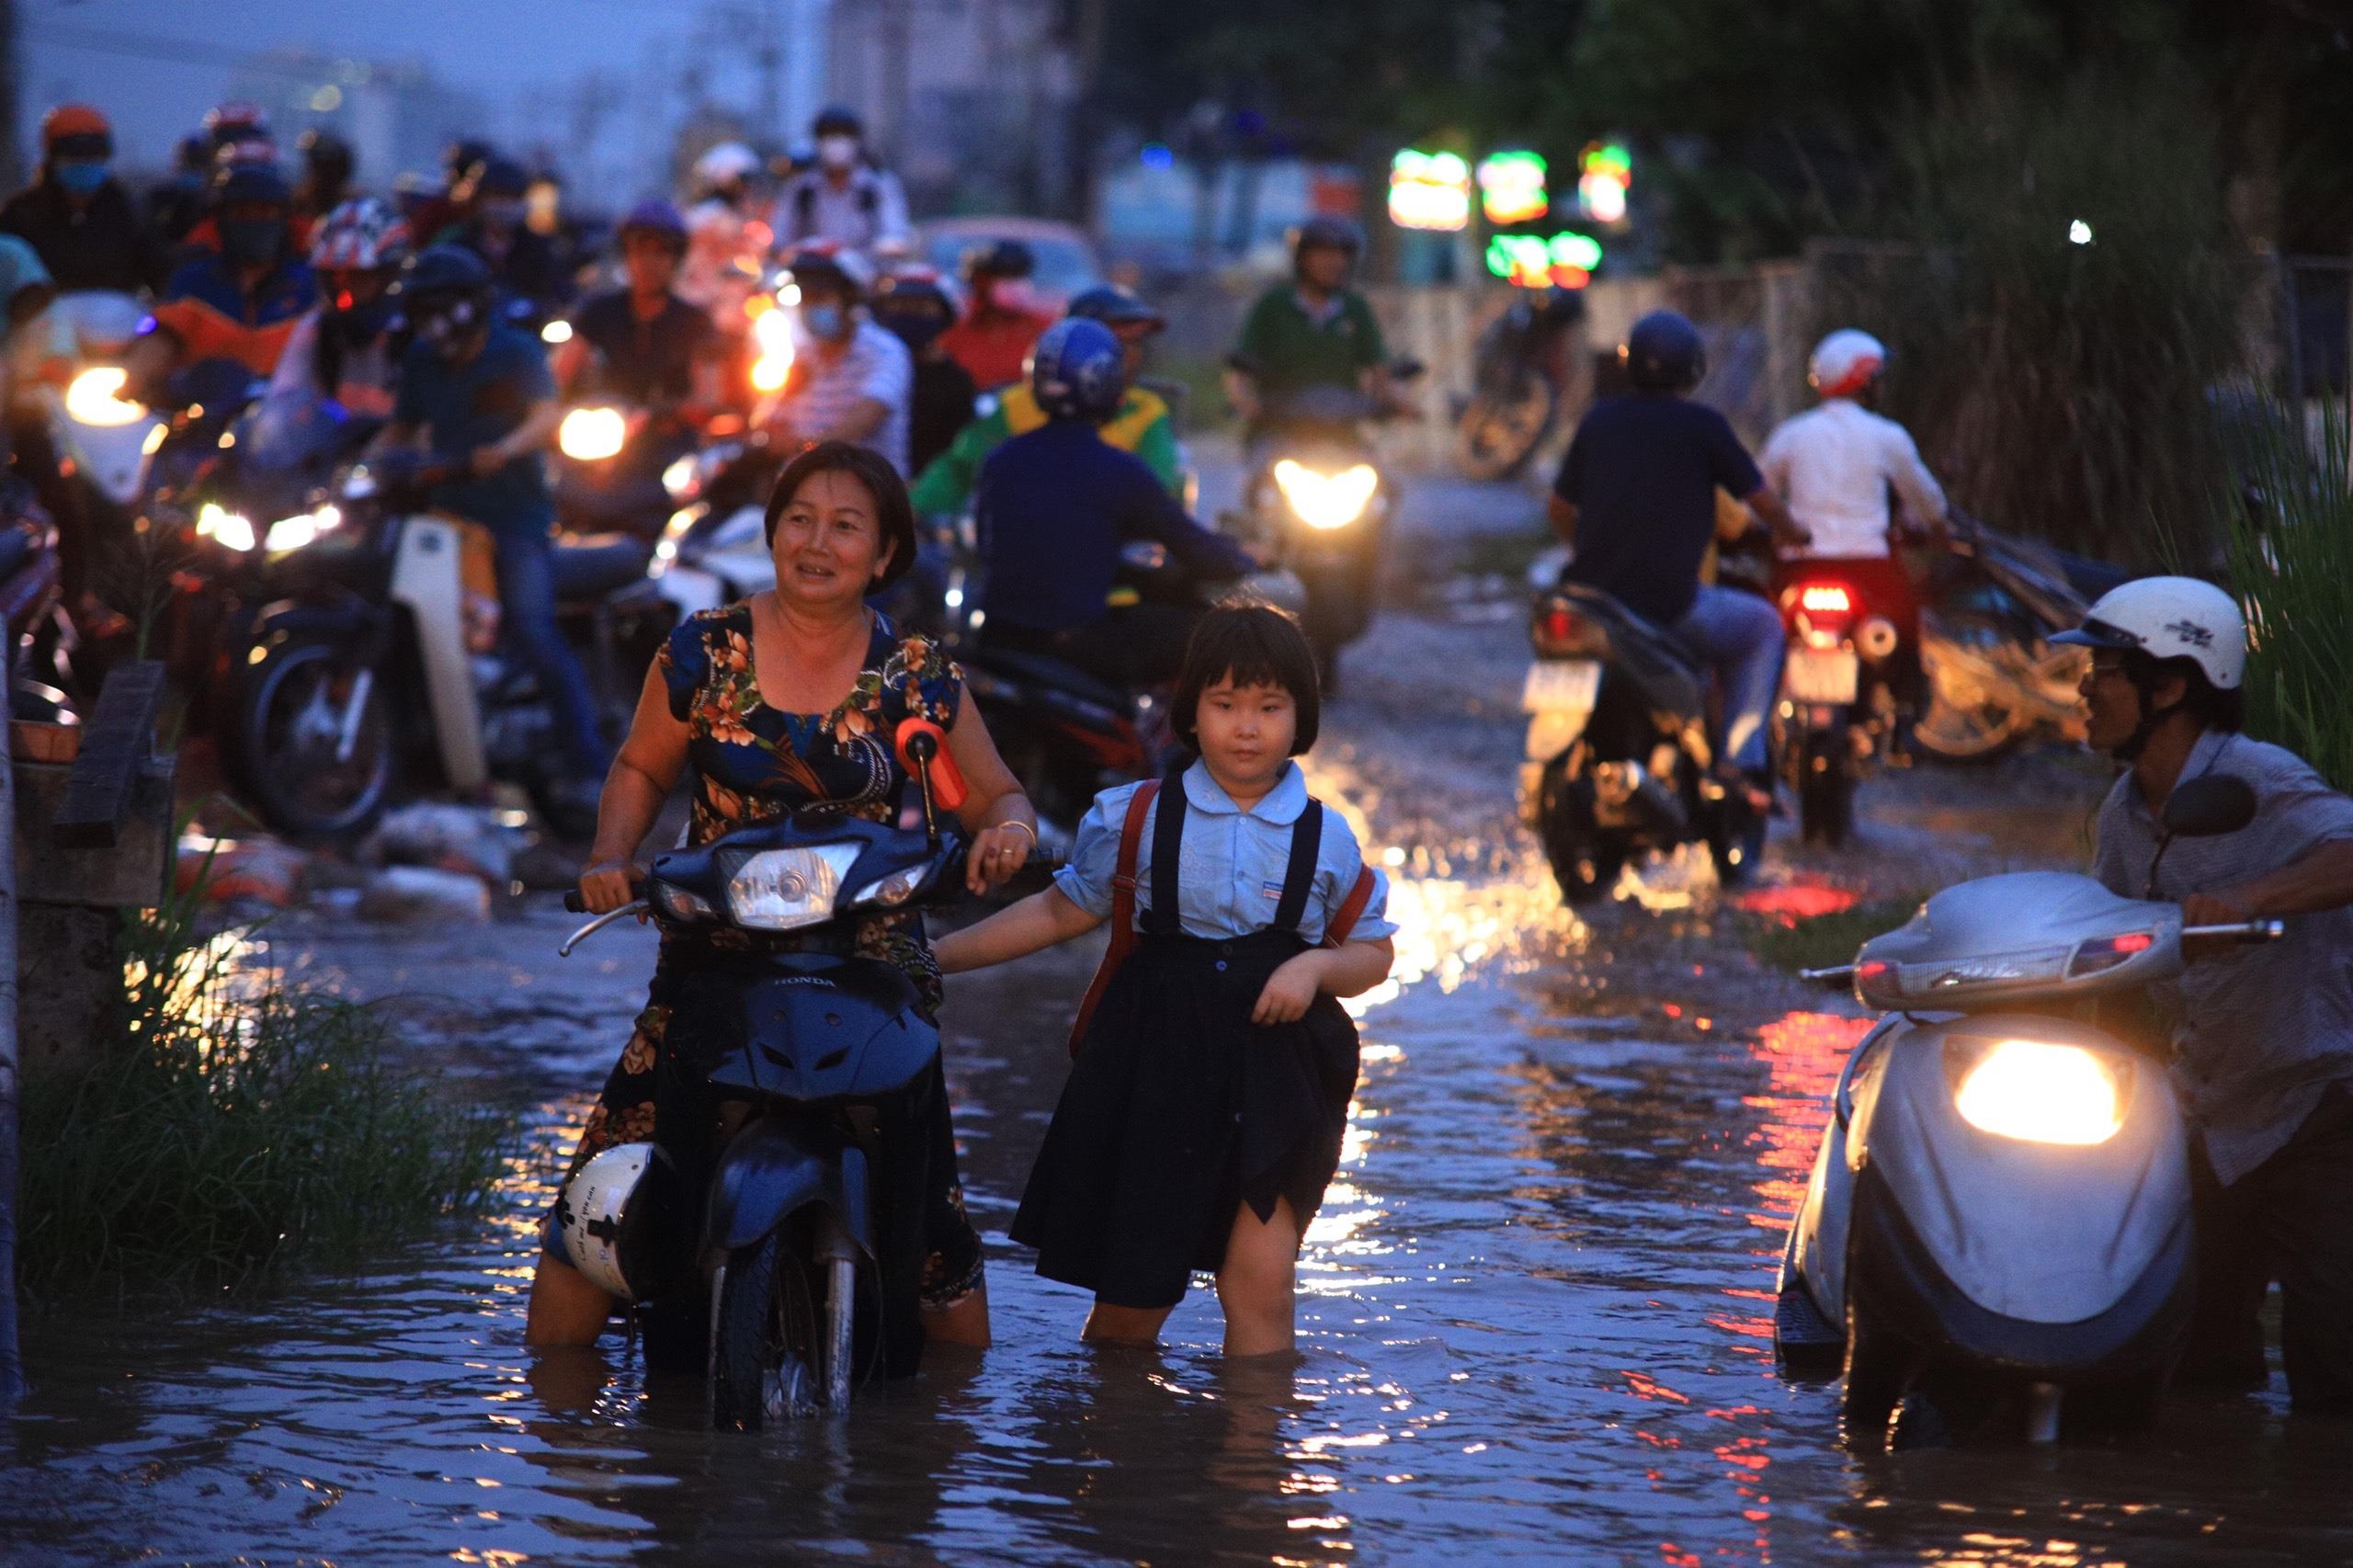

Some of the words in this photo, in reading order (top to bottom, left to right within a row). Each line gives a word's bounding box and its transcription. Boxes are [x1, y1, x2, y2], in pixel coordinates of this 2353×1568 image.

[773, 976, 837, 988] HONDA
[581, 1200, 590, 1216] you
[586, 1185, 597, 1201] can
